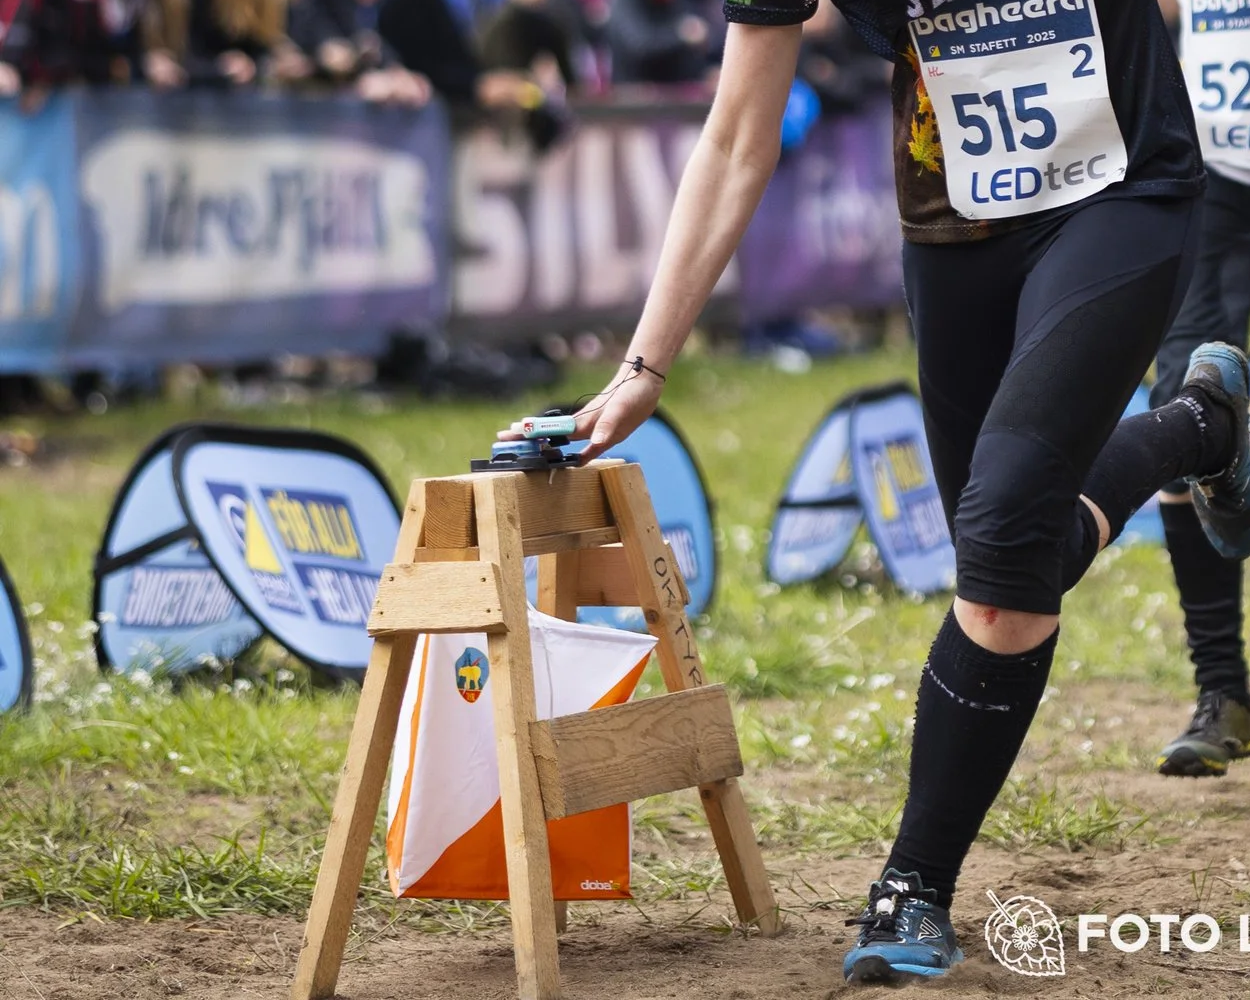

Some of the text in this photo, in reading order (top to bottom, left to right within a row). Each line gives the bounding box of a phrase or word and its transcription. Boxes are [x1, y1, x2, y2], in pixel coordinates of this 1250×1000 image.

[950, 29, 1056, 56] SM STAFETT 2025
[1069, 43, 1096, 79] 2
[951, 83, 1057, 157] 515
